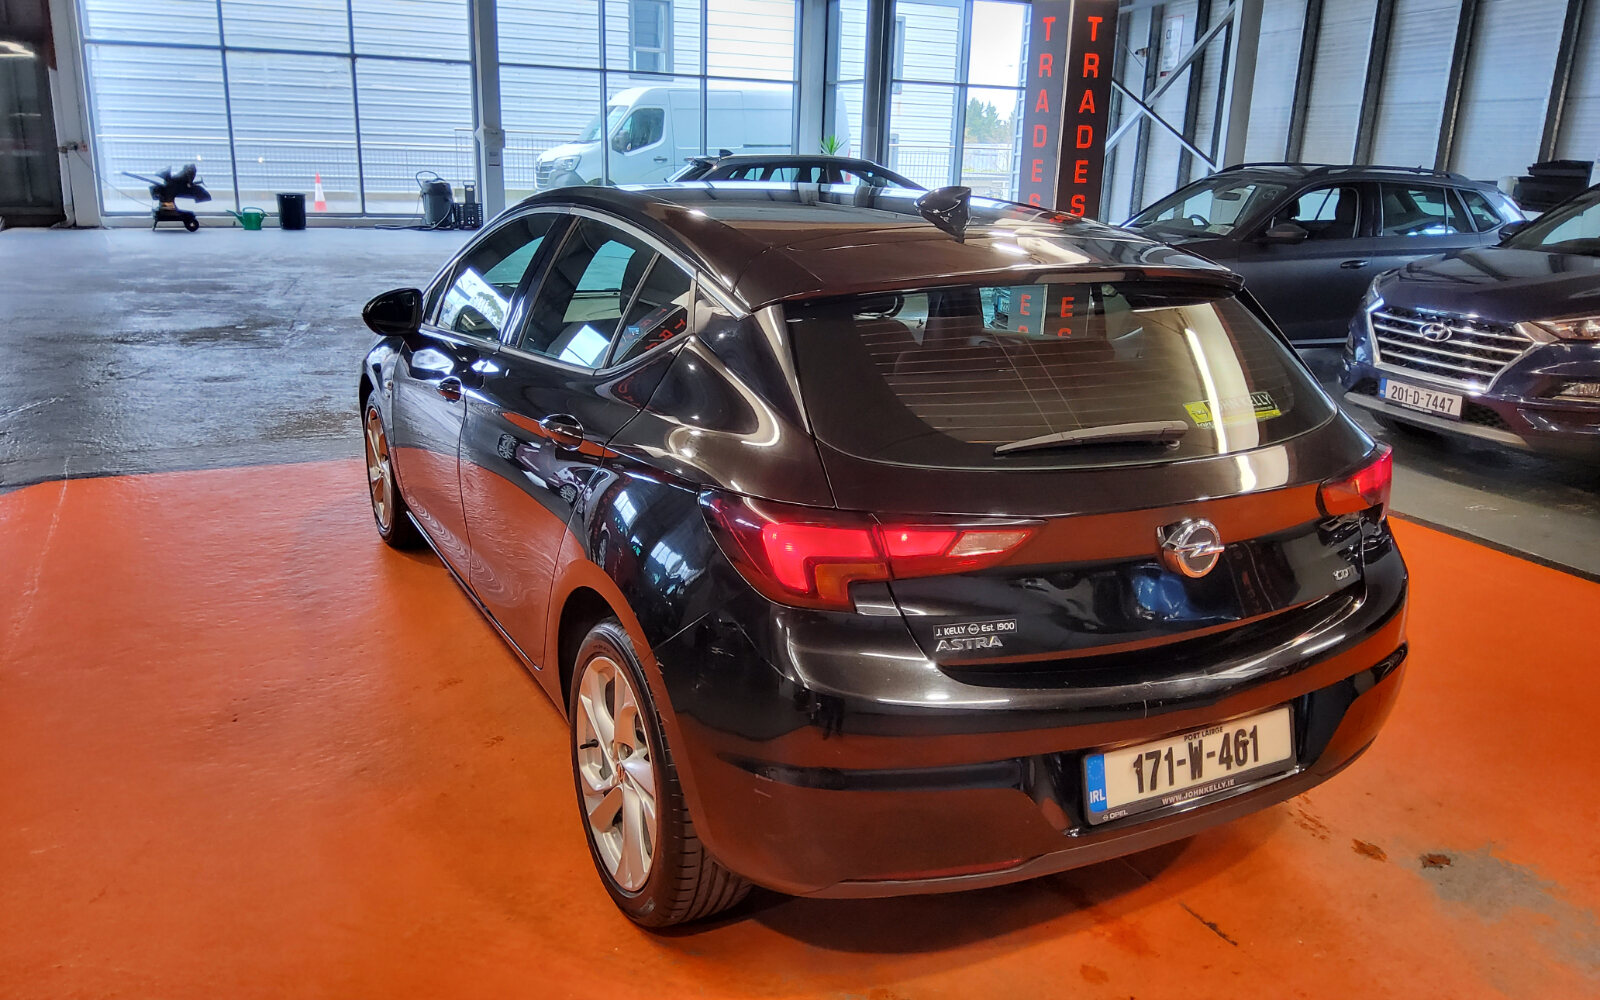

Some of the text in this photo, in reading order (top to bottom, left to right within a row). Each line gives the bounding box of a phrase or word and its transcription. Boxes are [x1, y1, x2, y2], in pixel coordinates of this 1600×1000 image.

[1070, 16, 1103, 217] TRADES
[1391, 385, 1454, 412] 201-D-7447
[944, 625, 966, 635] KELLY
[996, 622, 1015, 631] 1900
[936, 635, 1003, 652] ASTRA
[1184, 731, 1200, 742] PORT
[1133, 725, 1259, 793] 171-W-461
[1090, 788, 1106, 804] IRL
[1161, 778, 1235, 806] WWW.JOHNKELLY.IE
[1109, 810, 1128, 819] OPEL
